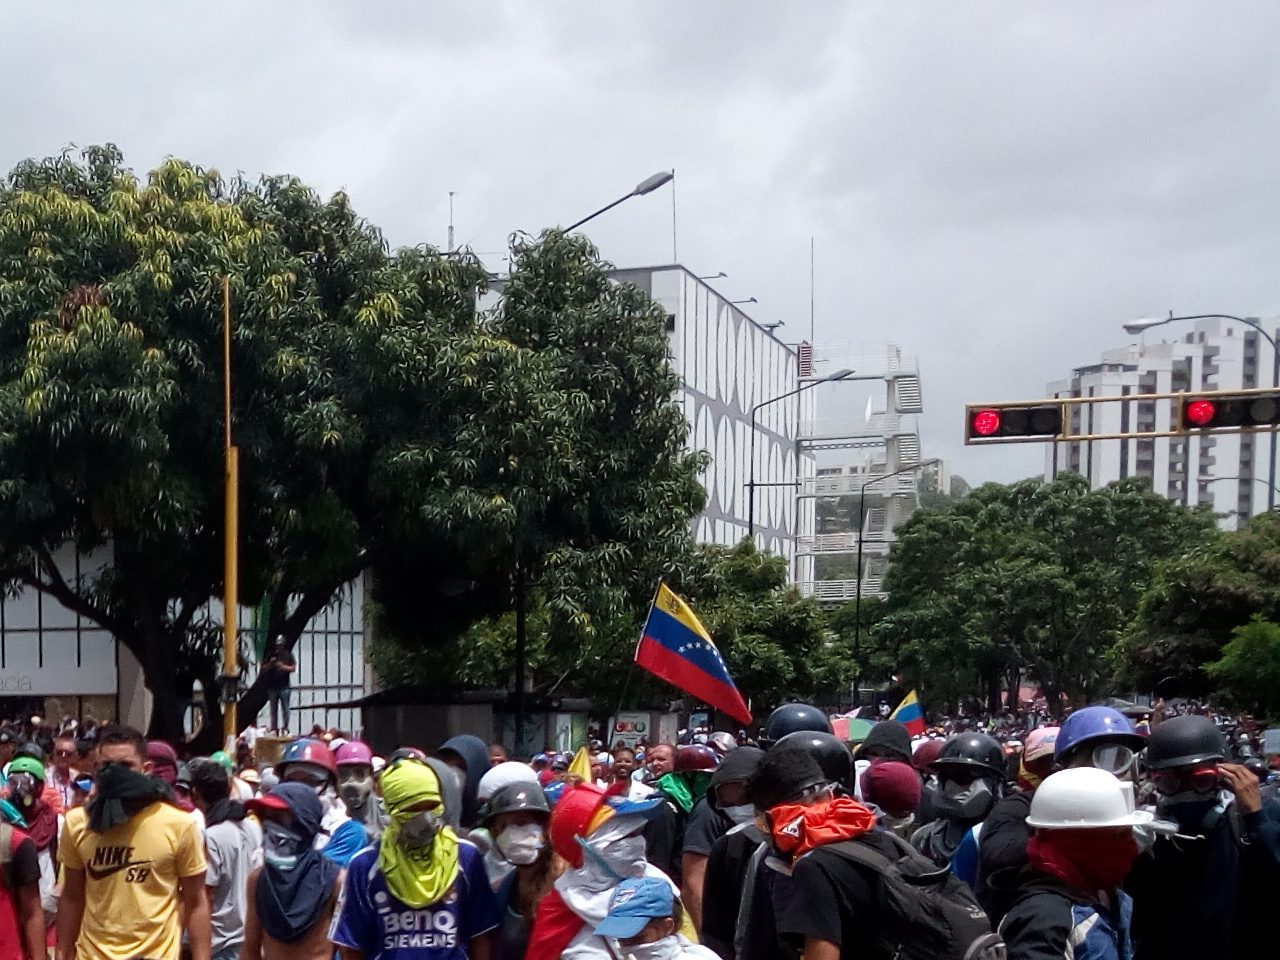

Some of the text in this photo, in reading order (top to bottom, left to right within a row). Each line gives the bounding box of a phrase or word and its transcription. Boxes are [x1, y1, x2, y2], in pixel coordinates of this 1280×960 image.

[94, 846, 136, 866] NIKE
[125, 866, 151, 884] SB
[381, 909, 459, 934] BenQ
[383, 932, 457, 949] SIEMENS
